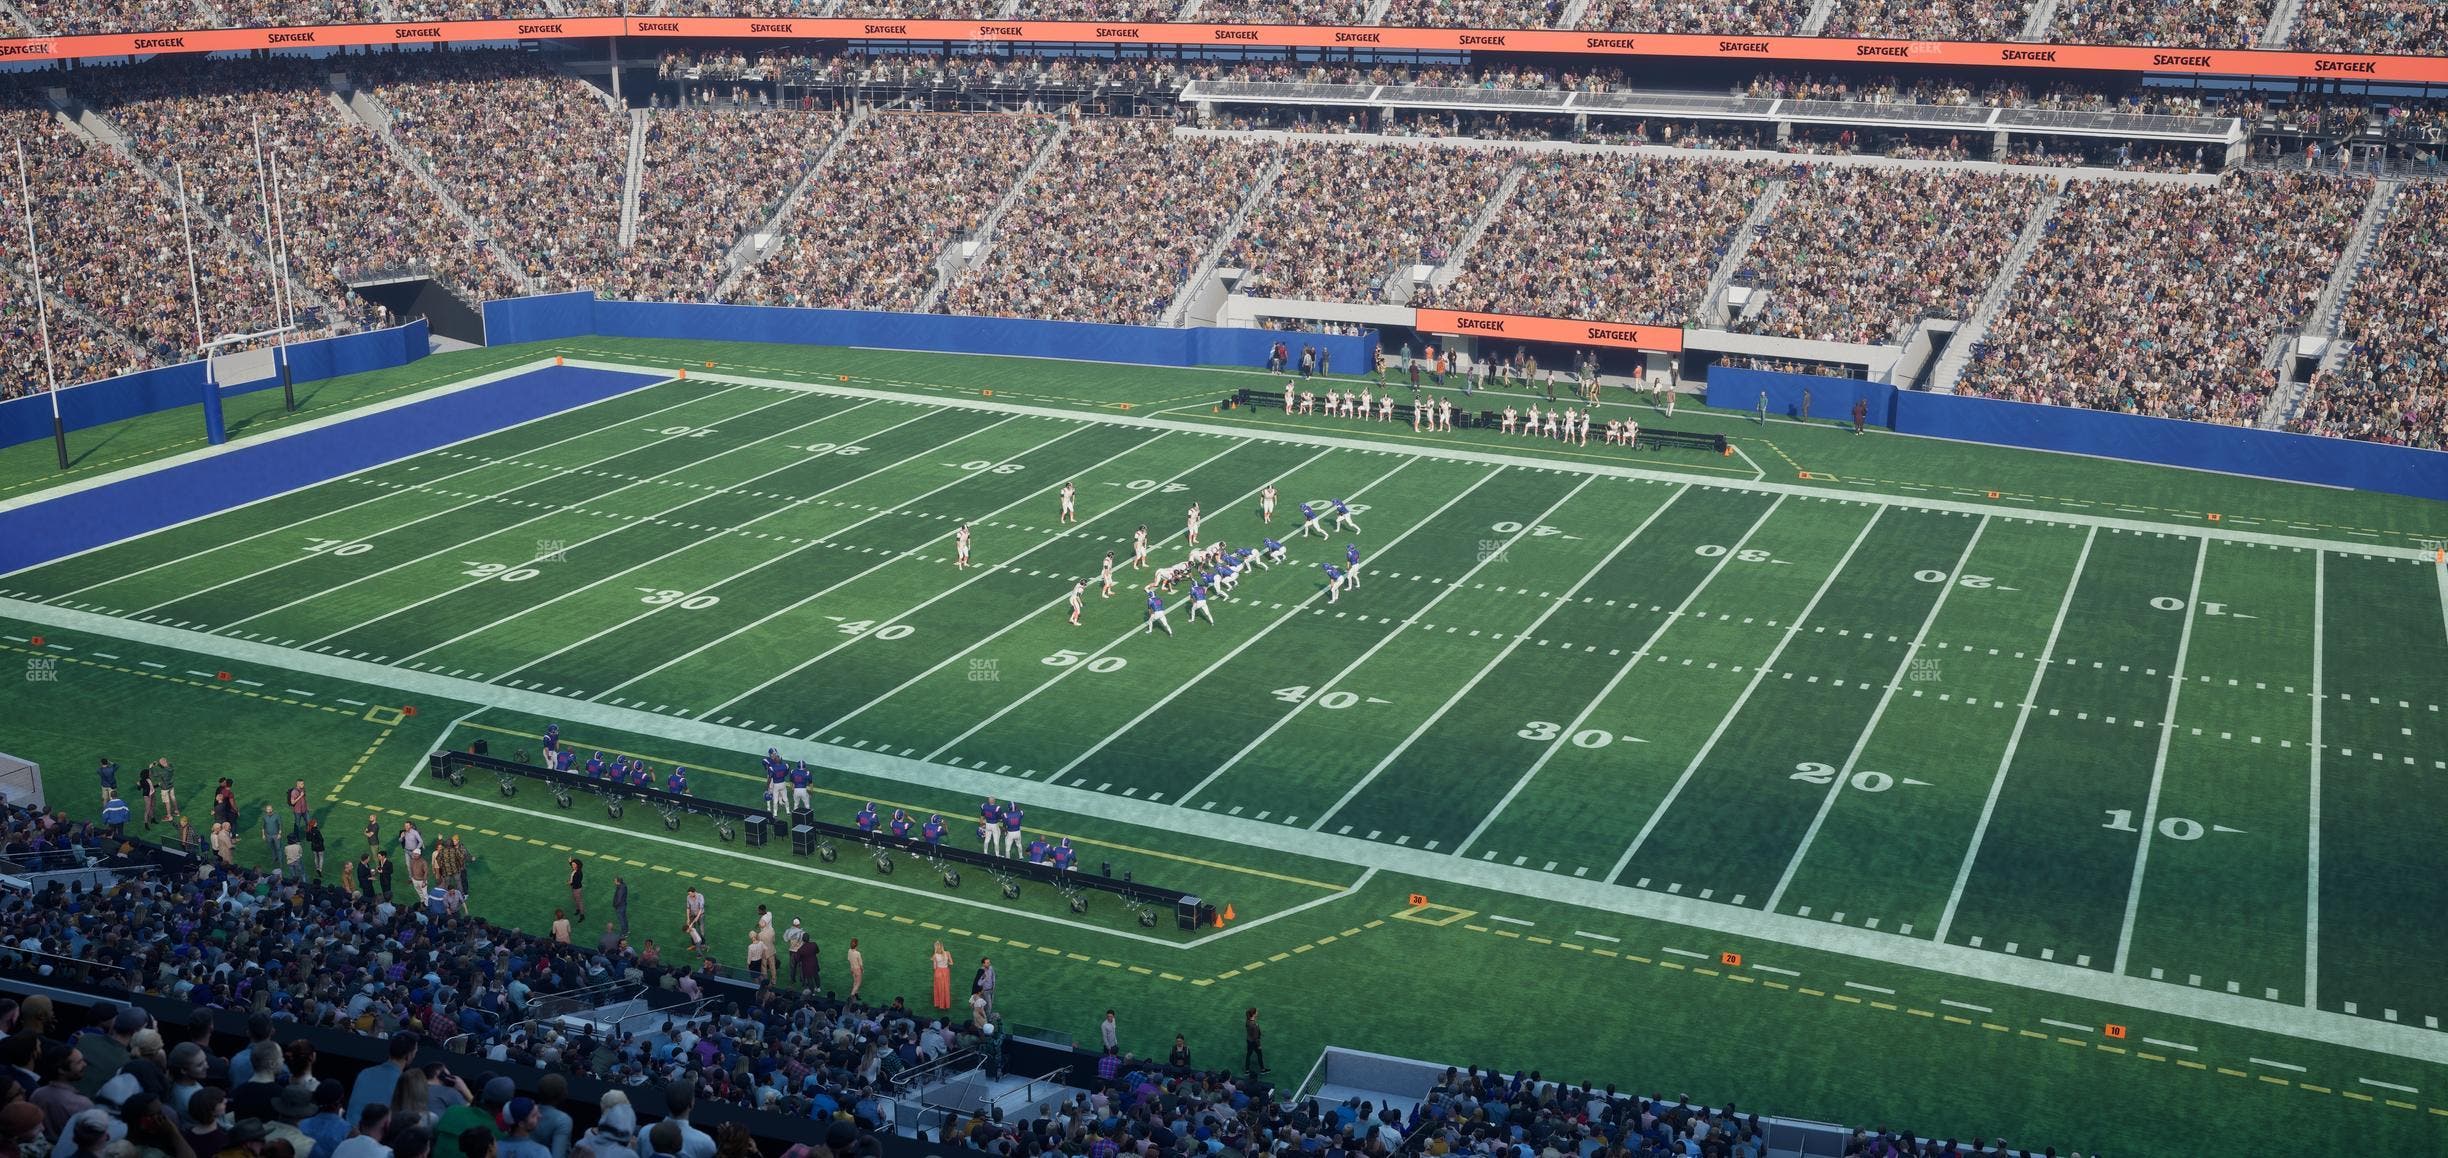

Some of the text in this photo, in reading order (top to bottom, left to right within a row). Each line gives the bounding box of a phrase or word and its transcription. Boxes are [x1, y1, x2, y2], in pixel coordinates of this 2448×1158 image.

[396, 28, 441, 38] SEATGEEK
[519, 24, 562, 34] SEATGEEK
[639, 23, 678, 32] SEATGEEK
[751, 24, 792, 33] SEATGEEK
[865, 25, 906, 34] SEATGEEK
[980, 26, 1023, 36] SEATGEEK
[1097, 28, 1139, 38] SEATGEEK
[268, 32, 315, 43] SEATGEEK
[1215, 30, 1258, 40] SEATGEEK
[1336, 33, 1380, 43] SEATGEEK
[1460, 35, 1505, 45] SEATGEEK
[135, 38, 184, 49] SEATGEEK
[1587, 39, 1634, 50] SEATGEEK
[1720, 41, 1769, 52] SEATGEEK
[1857, 46, 1908, 57] SEATGEEK
[2002, 49, 2056, 62] SEATGEEK
[2153, 54, 2210, 67] SEATGEEK
[2315, 60, 2376, 73] SEATGEEK
[1458, 318, 1504, 331] SEATGEEK
[1589, 328, 1637, 342] SEATGEEK
[303, 540, 374, 556] 10
[462, 563, 540, 582] 20
[641, 590, 721, 610] 30
[837, 619, 916, 640] 40
[1041, 649, 1128, 673] 50
[1271, 685, 1359, 709] 40
[1517, 721, 1614, 749] 30
[1789, 761, 1894, 793] 20
[2102, 809, 2205, 841] 10
[1413, 896, 1423, 905] 30
[1726, 954, 1736, 963] 20
[2111, 1026, 2120, 1036] 10
